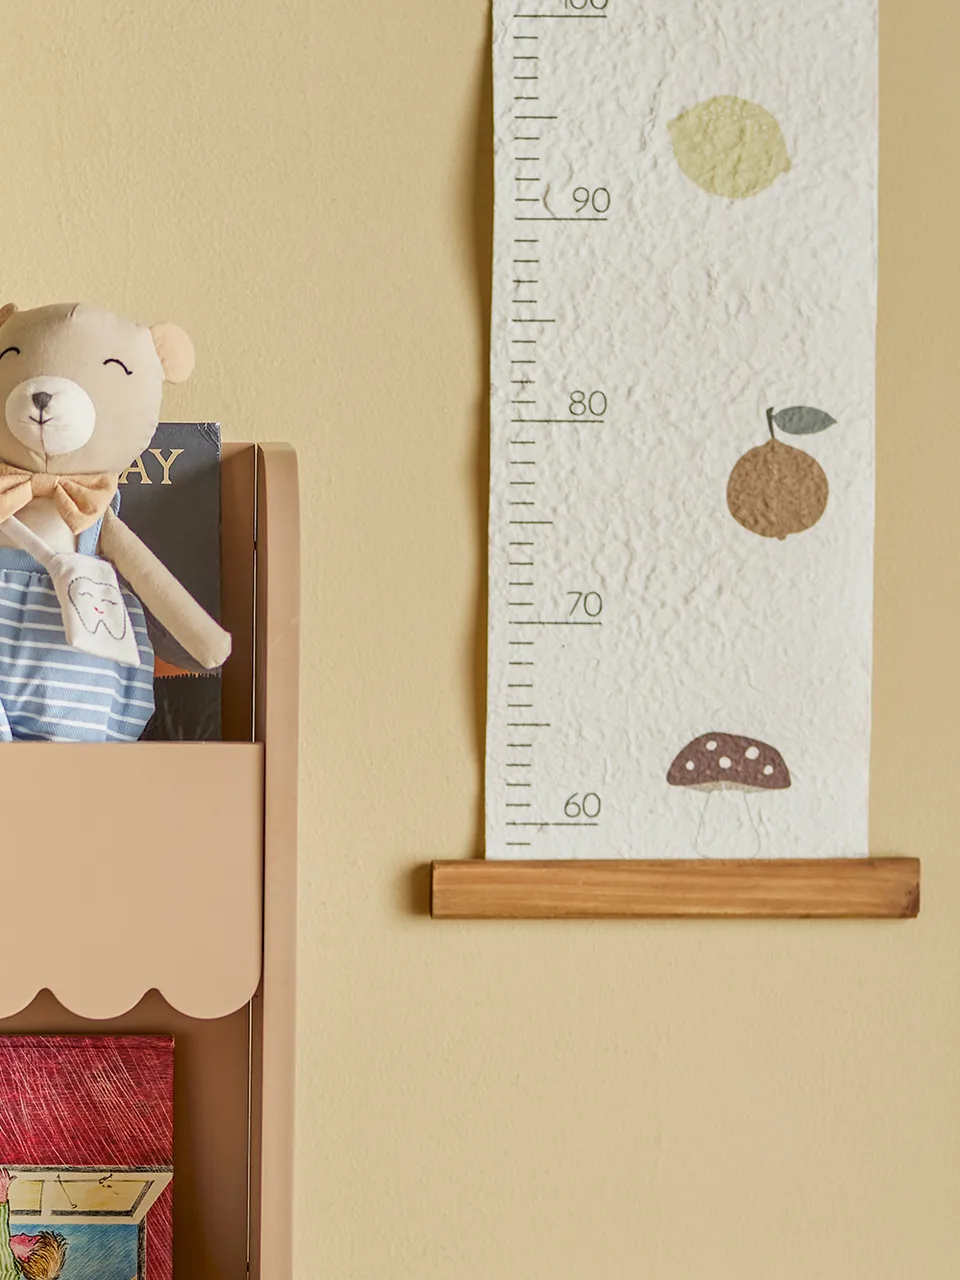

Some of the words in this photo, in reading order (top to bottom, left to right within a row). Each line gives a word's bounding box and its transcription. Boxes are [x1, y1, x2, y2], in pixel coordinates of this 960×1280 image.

[572, 186, 611, 214] 90
[569, 390, 608, 416] 80
[118, 448, 185, 485] AY
[566, 591, 603, 617] 70
[564, 792, 601, 819] 60
